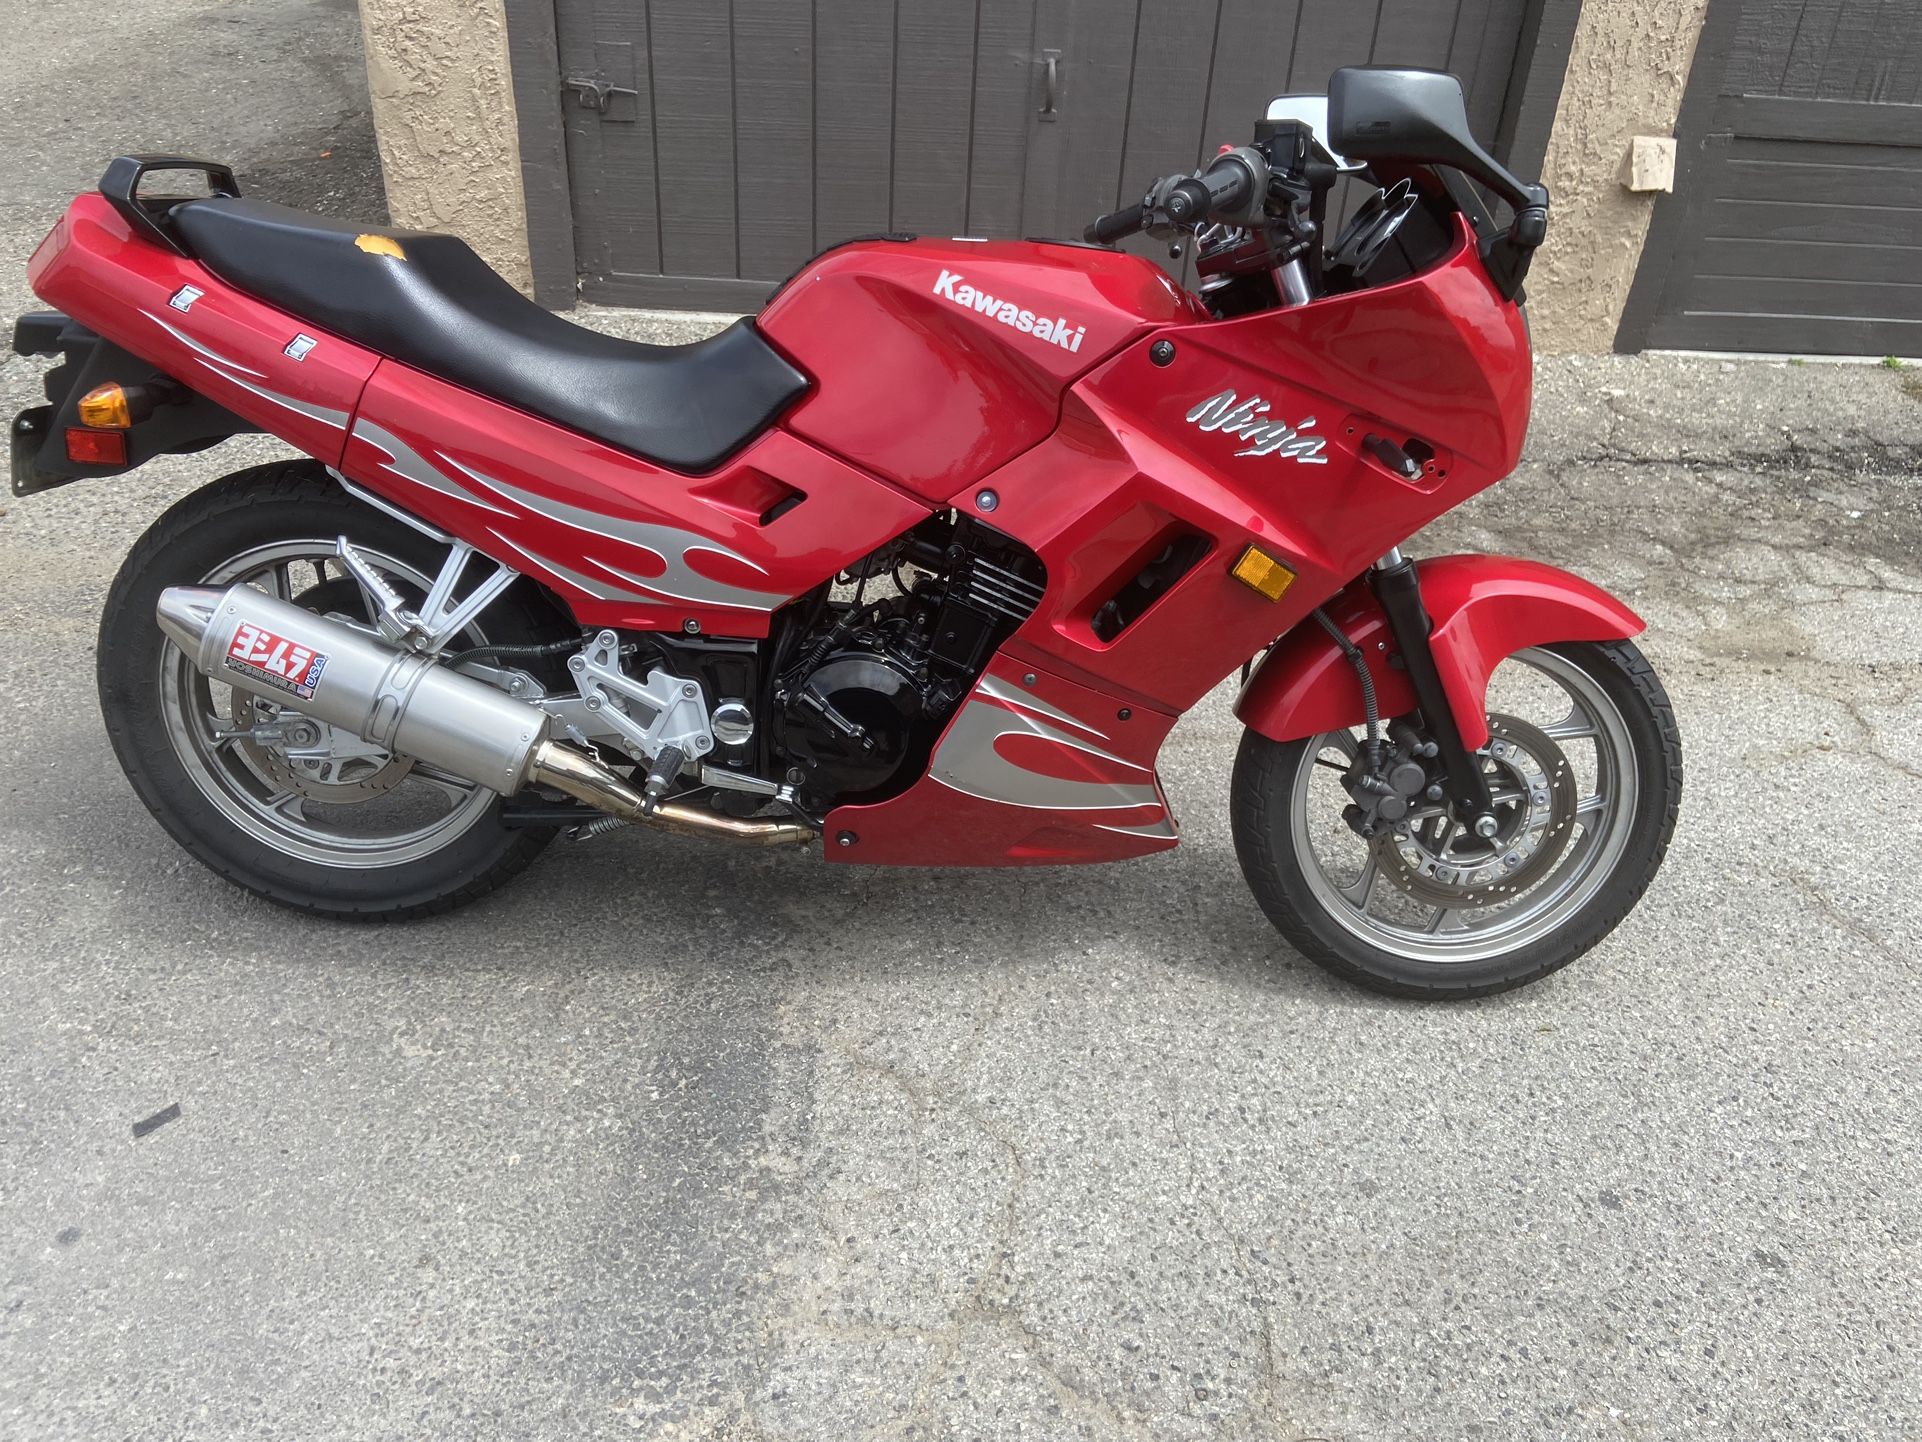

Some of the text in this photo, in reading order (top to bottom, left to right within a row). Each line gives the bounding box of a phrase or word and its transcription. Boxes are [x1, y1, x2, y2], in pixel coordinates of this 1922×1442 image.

[932, 269, 1087, 353] Kawasaki
[1185, 388, 1329, 464] Ninja
[228, 657, 297, 691] YOSHIMURA
[232, 625, 312, 680] ヨシムラ
[304, 657, 326, 687] USA
